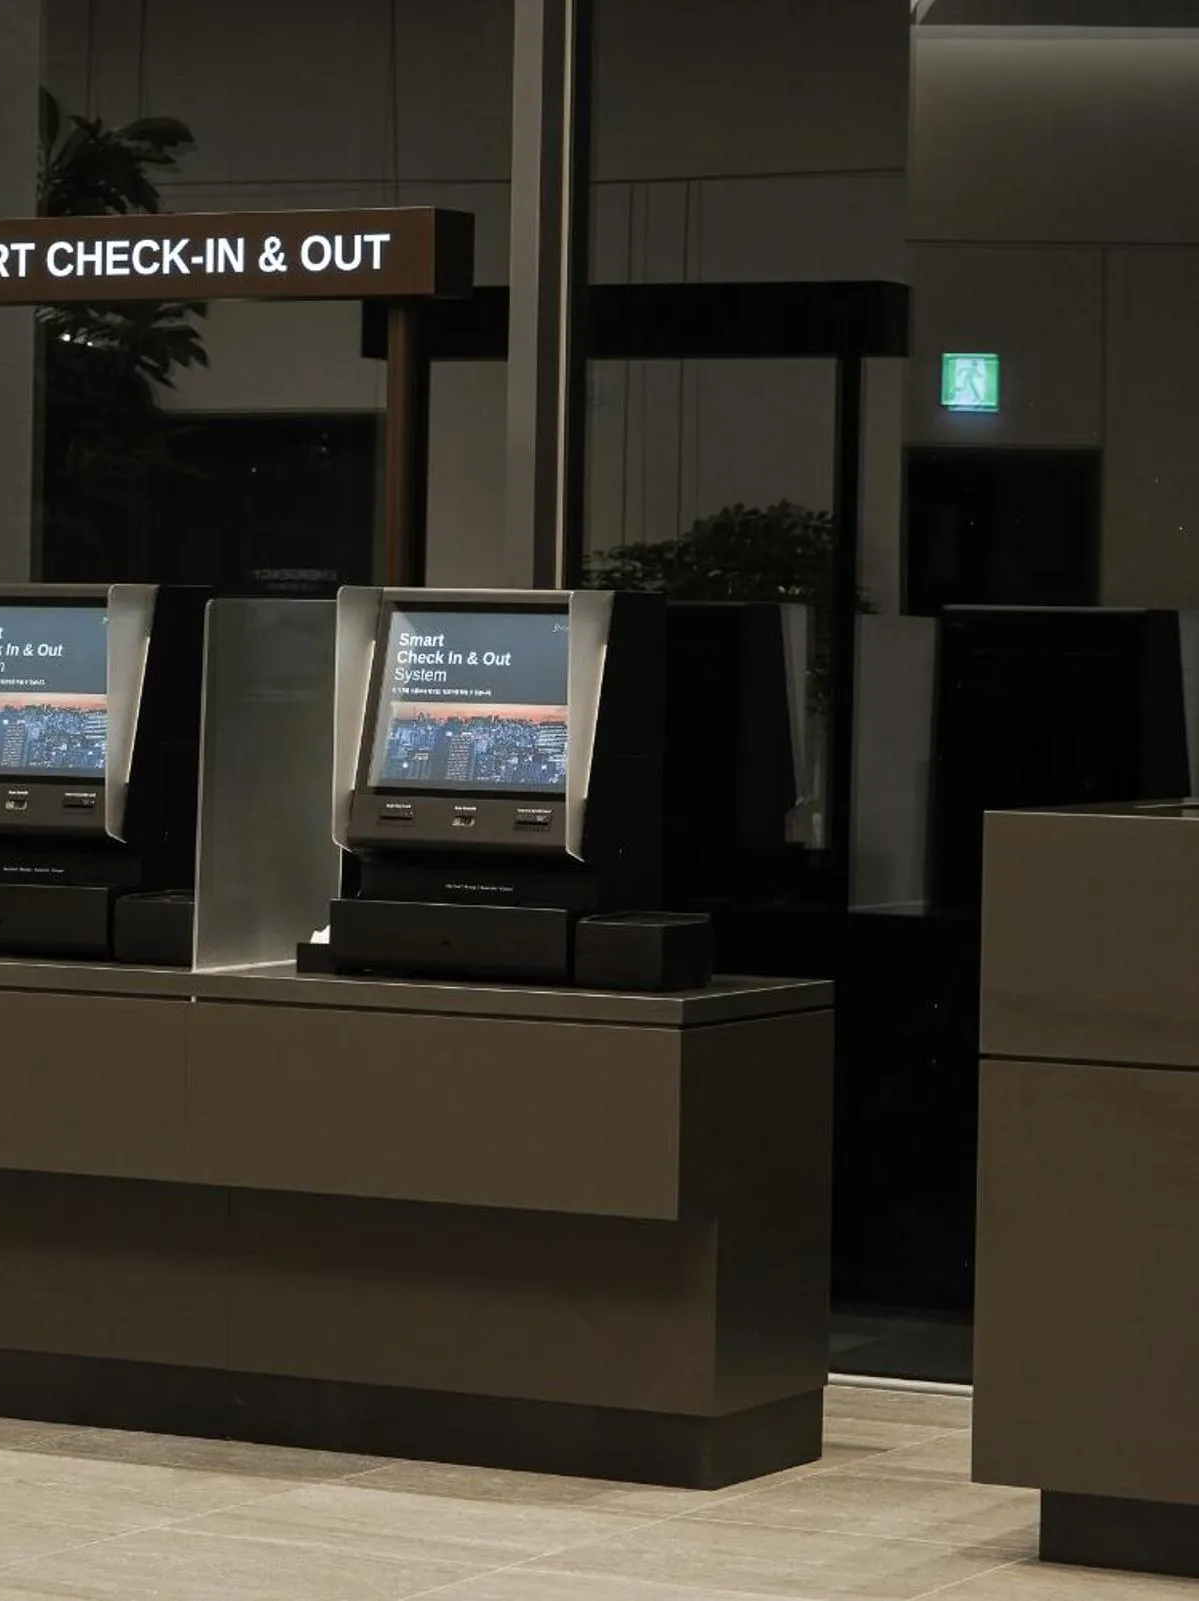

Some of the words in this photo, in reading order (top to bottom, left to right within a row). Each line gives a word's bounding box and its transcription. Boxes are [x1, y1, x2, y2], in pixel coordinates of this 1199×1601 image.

[46, 237, 245, 278] CHECK-IN
[258, 236, 287, 274] &
[300, 233, 391, 272] OUT
[399, 633, 445, 647] Smart
[6, 643, 19, 656] In
[23, 643, 34, 657] &
[37, 643, 63, 657] Out
[397, 650, 444, 664] Check
[448, 652, 463, 665] In
[467, 651, 479, 666] &
[483, 652, 512, 666] Out
[394, 667, 447, 683] System
